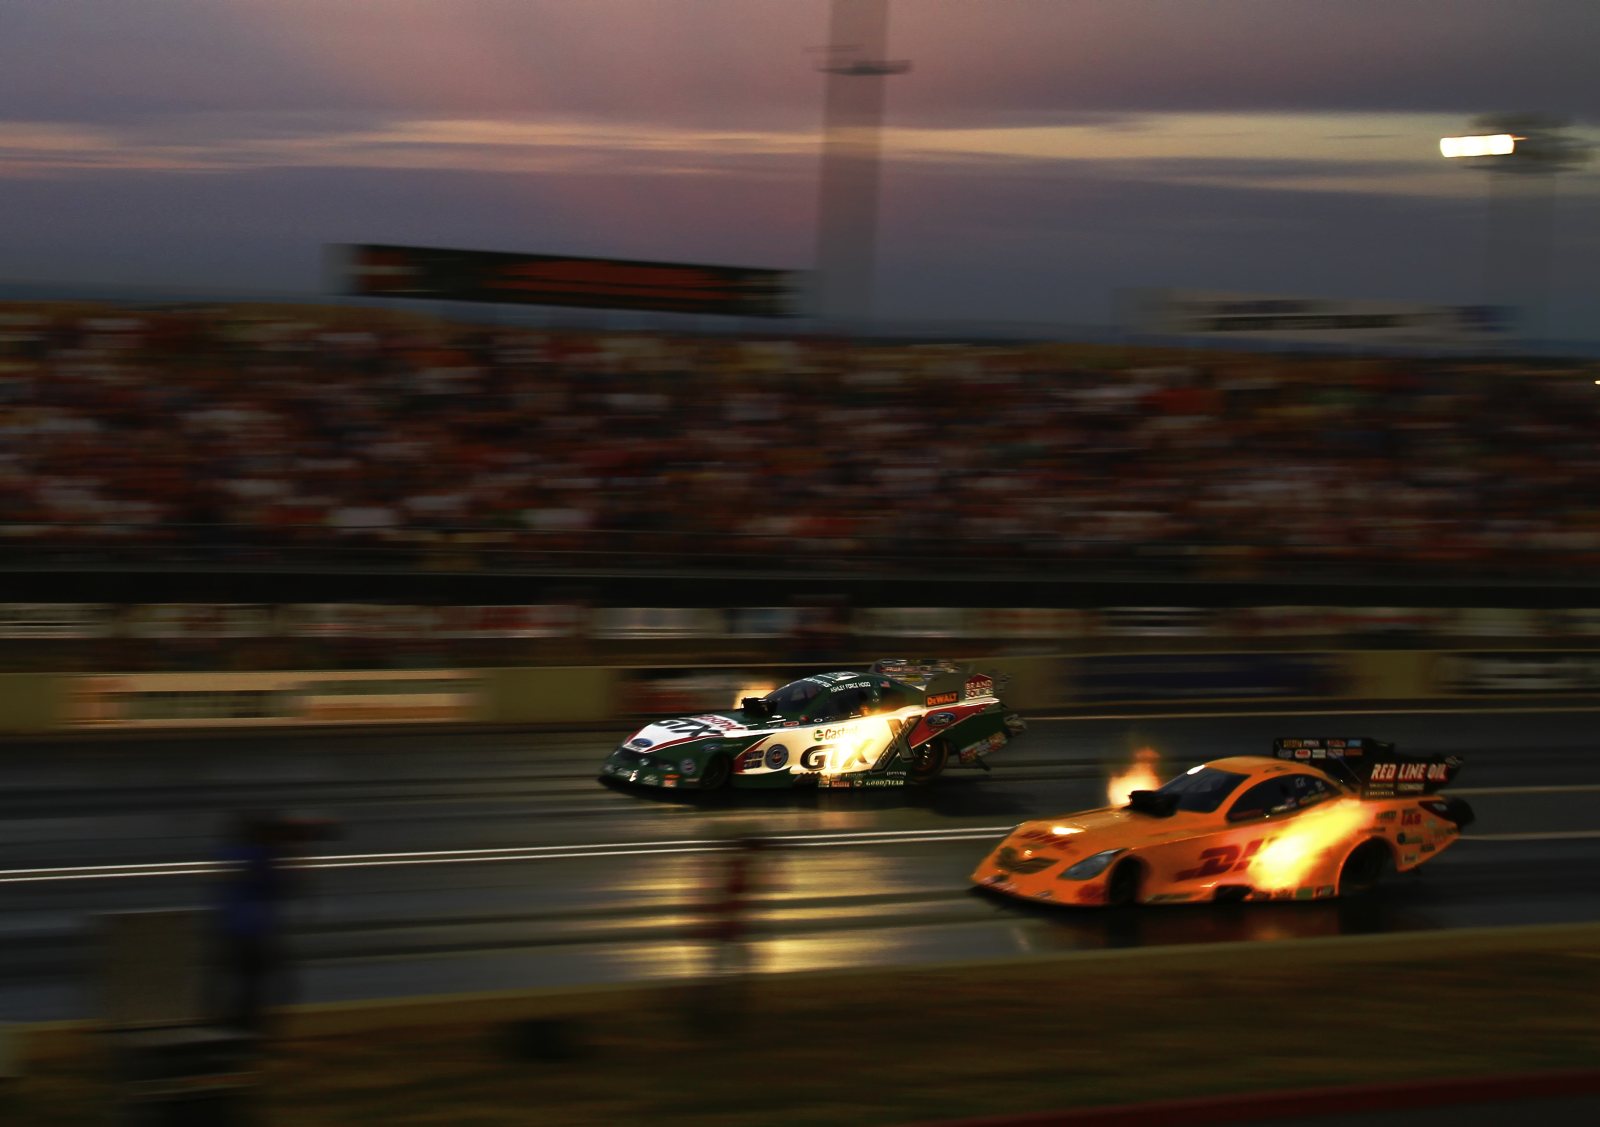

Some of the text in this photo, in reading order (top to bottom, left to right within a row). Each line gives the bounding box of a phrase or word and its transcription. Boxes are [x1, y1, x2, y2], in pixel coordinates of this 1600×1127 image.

[830, 685, 845, 693] ASHLEY
[966, 679, 993, 690] BRAND
[927, 693, 958, 706] DeWALT
[824, 727, 856, 740] Cast
[1370, 763, 1447, 782] RED LINE OIL
[866, 779, 905, 787] GOODYEAR
